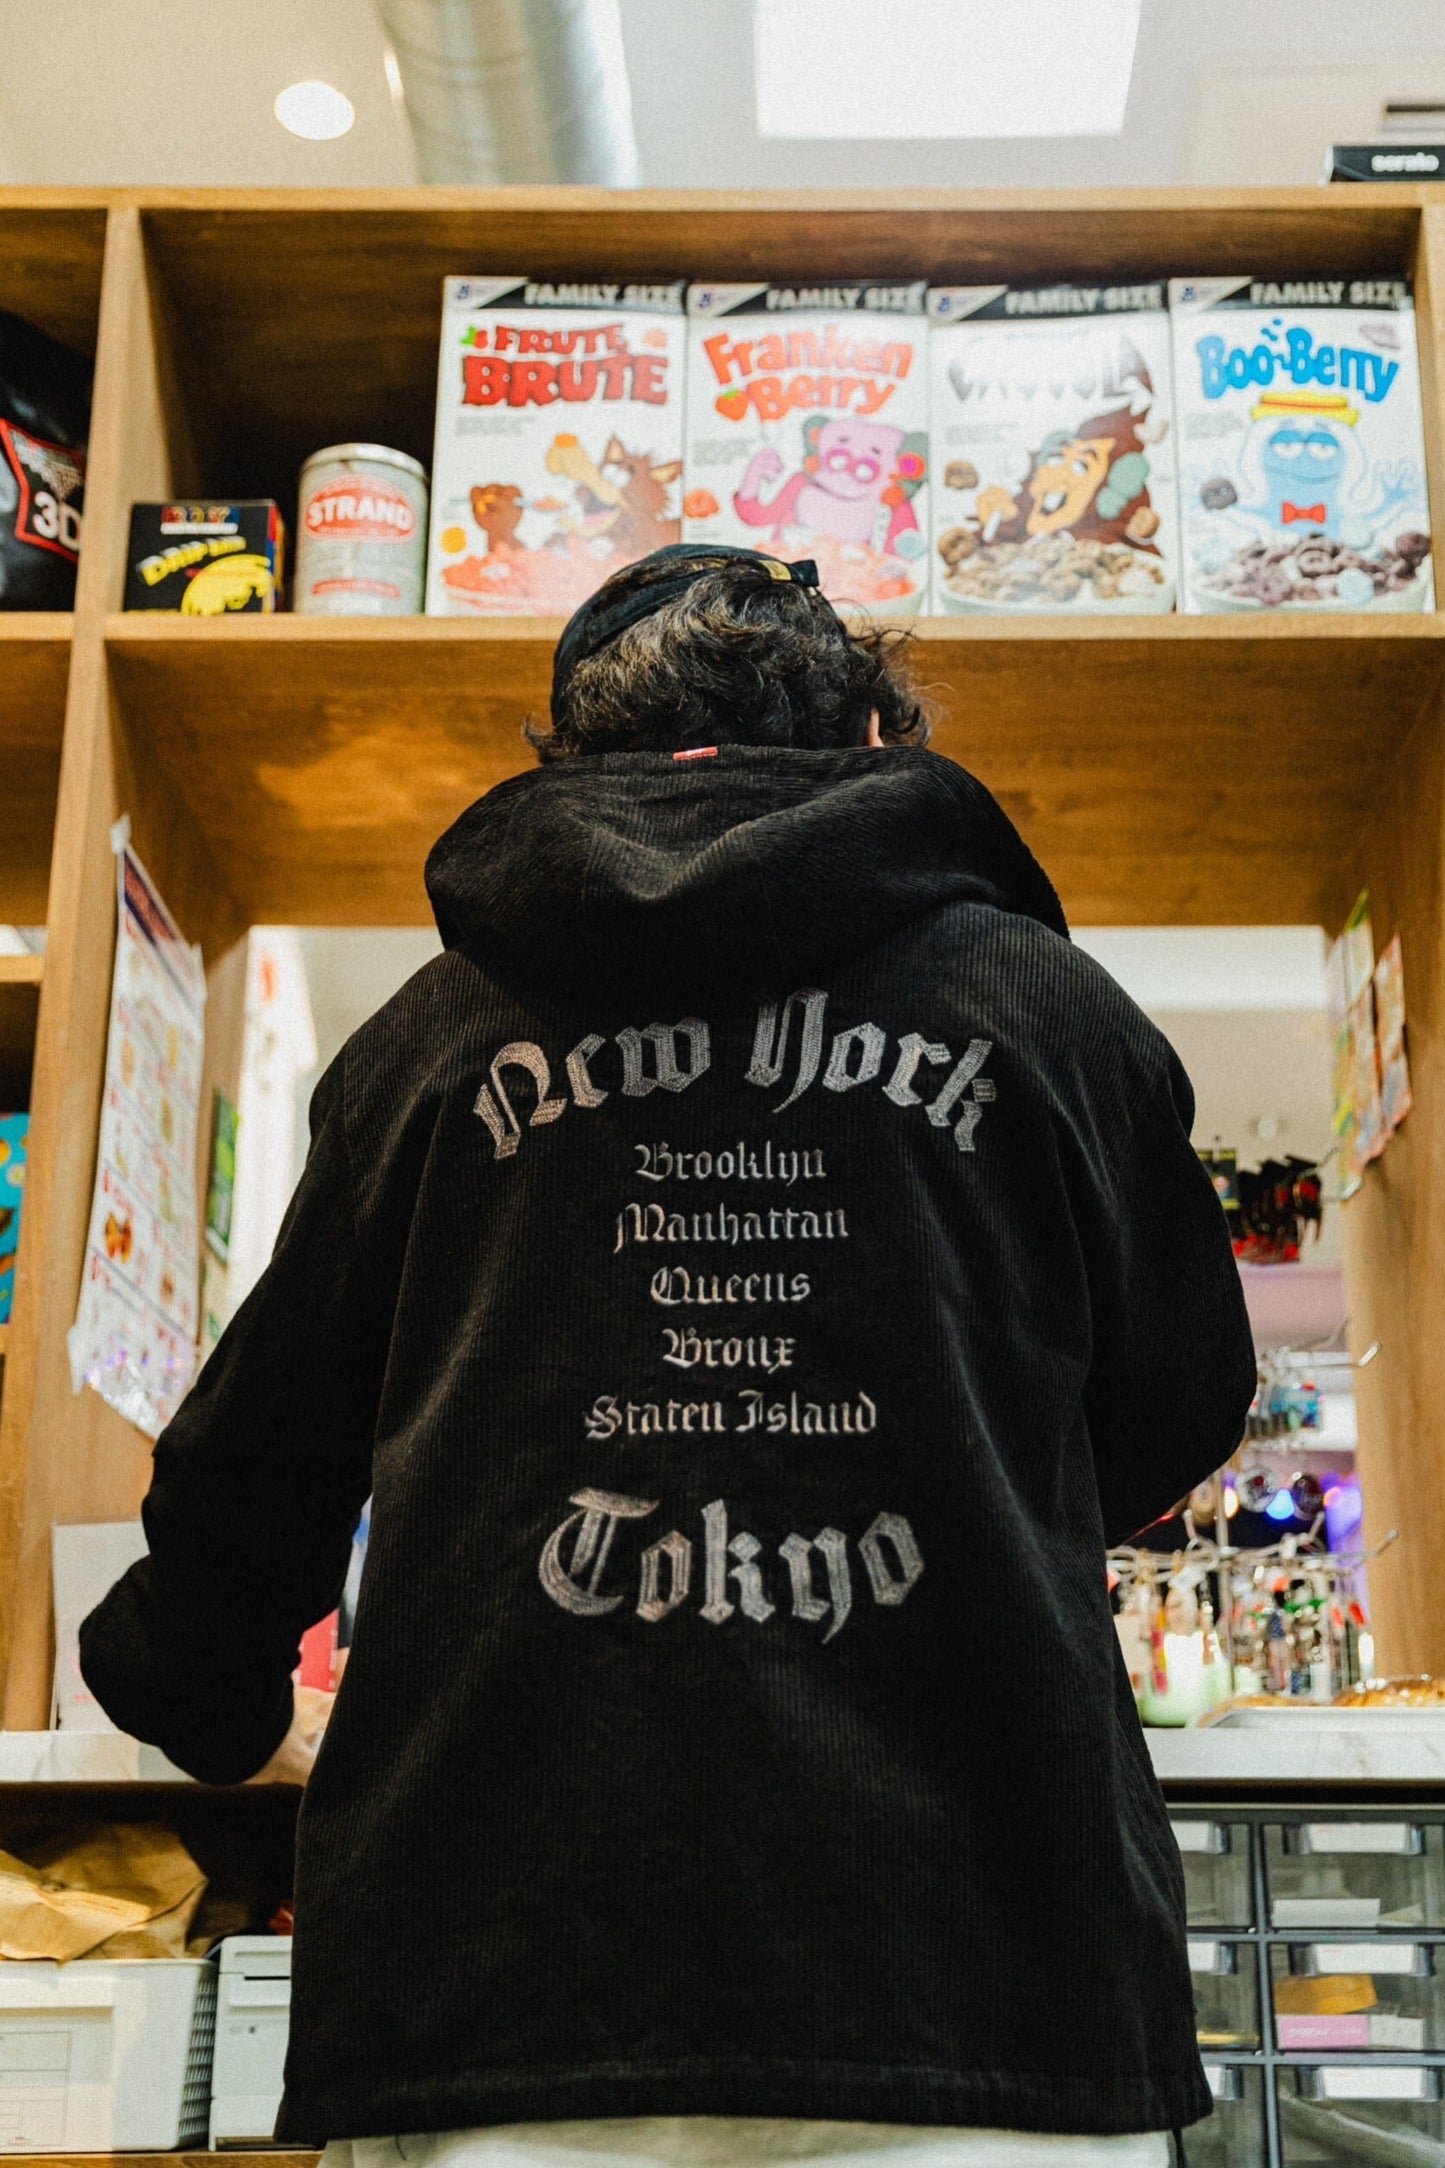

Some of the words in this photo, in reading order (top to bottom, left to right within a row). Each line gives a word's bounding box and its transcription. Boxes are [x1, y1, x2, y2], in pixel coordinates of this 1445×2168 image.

[524, 283, 619, 305] FAMILY
[623, 284, 683, 308] SIZE
[766, 287, 860, 310] FAMILY
[1005, 288, 1098, 314] FAMILY
[1102, 285, 1163, 310] SIZE
[1250, 282, 1345, 305] FAMILY
[1350, 281, 1408, 305] SIZE
[494, 324, 628, 355] FRUTE
[703, 323, 914, 385] Franken
[463, 354, 669, 407] BRUTE
[747, 374, 897, 422] Berry
[308, 495, 412, 530] STRAND
[473, 1015, 711, 1161] New
[743, 989, 997, 1153] York
[633, 1140, 828, 1187] Brooklyn
[613, 1202, 849, 1254] Manhattan
[650, 1265, 812, 1306] Queens
[661, 1327, 797, 1374] Bronx
[583, 1394, 727, 1439] Staten
[735, 1390, 878, 1435] Island
[538, 1486, 925, 1645] Tokyo
